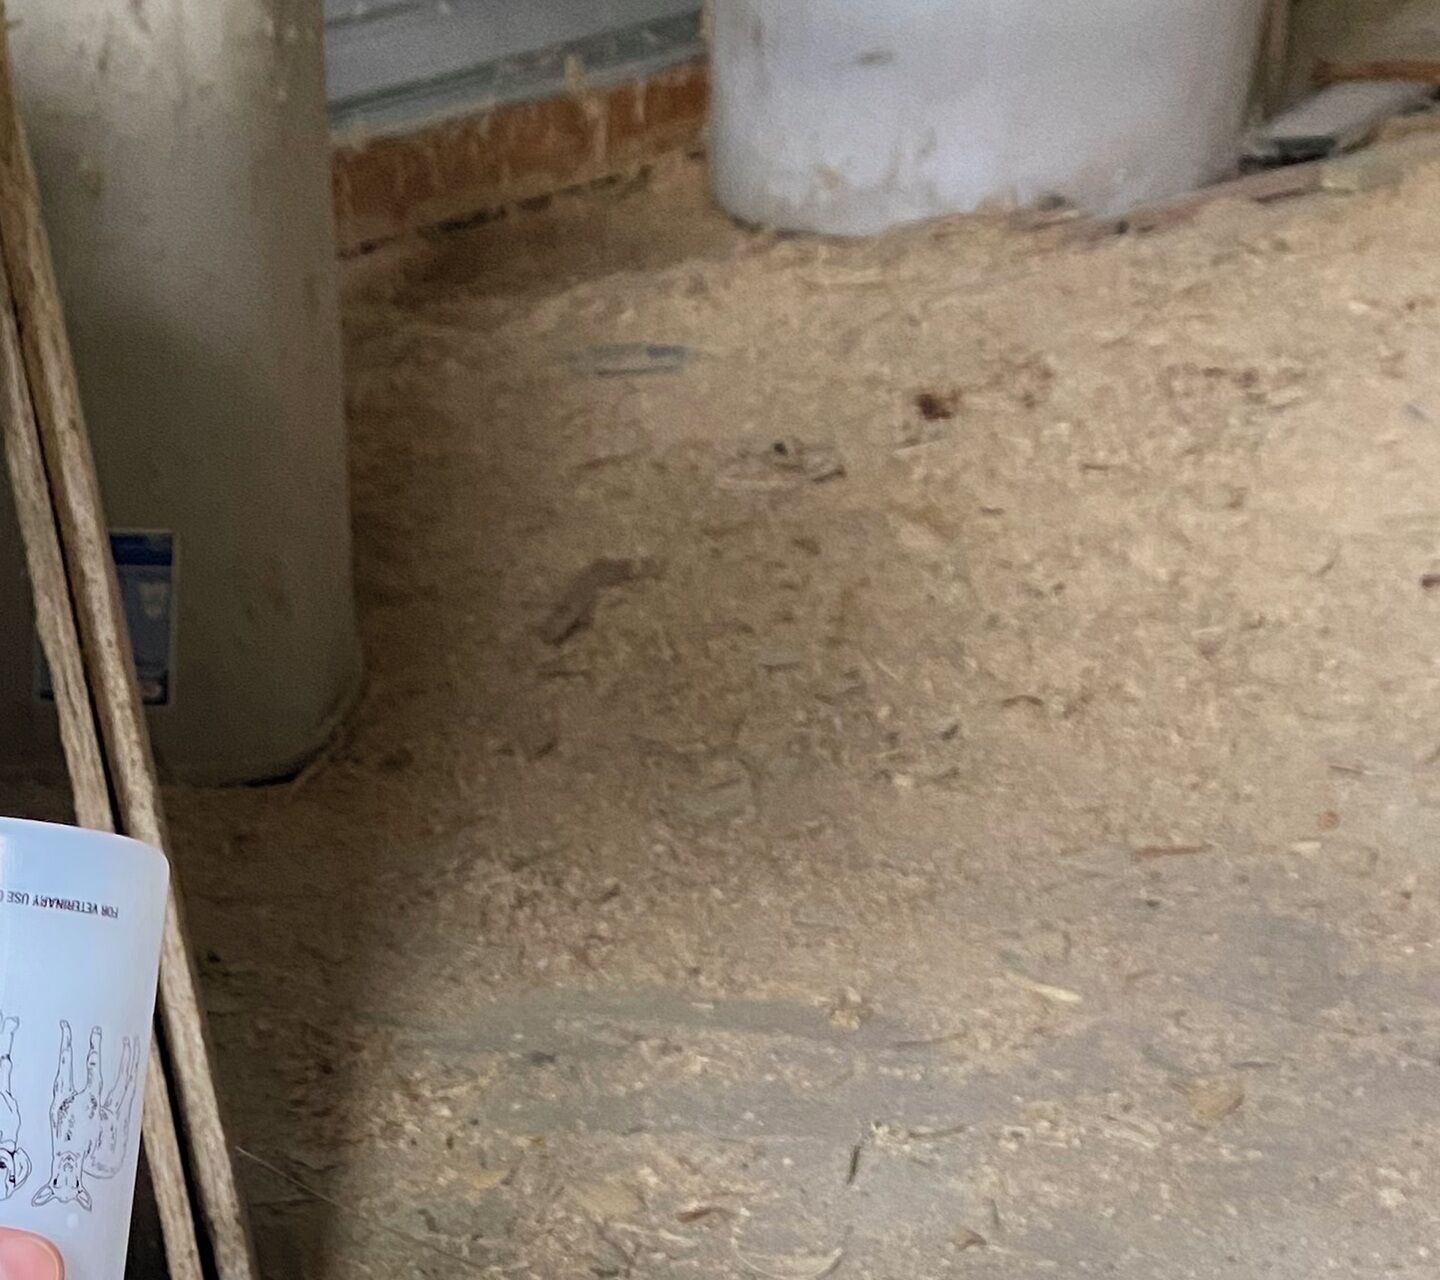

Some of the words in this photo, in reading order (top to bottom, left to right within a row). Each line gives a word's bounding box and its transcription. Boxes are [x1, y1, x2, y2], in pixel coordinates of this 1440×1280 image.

[7, 891, 29, 905] USE
[32, 895, 98, 914] VETERINARY
[101, 905, 119, 918] FOR
